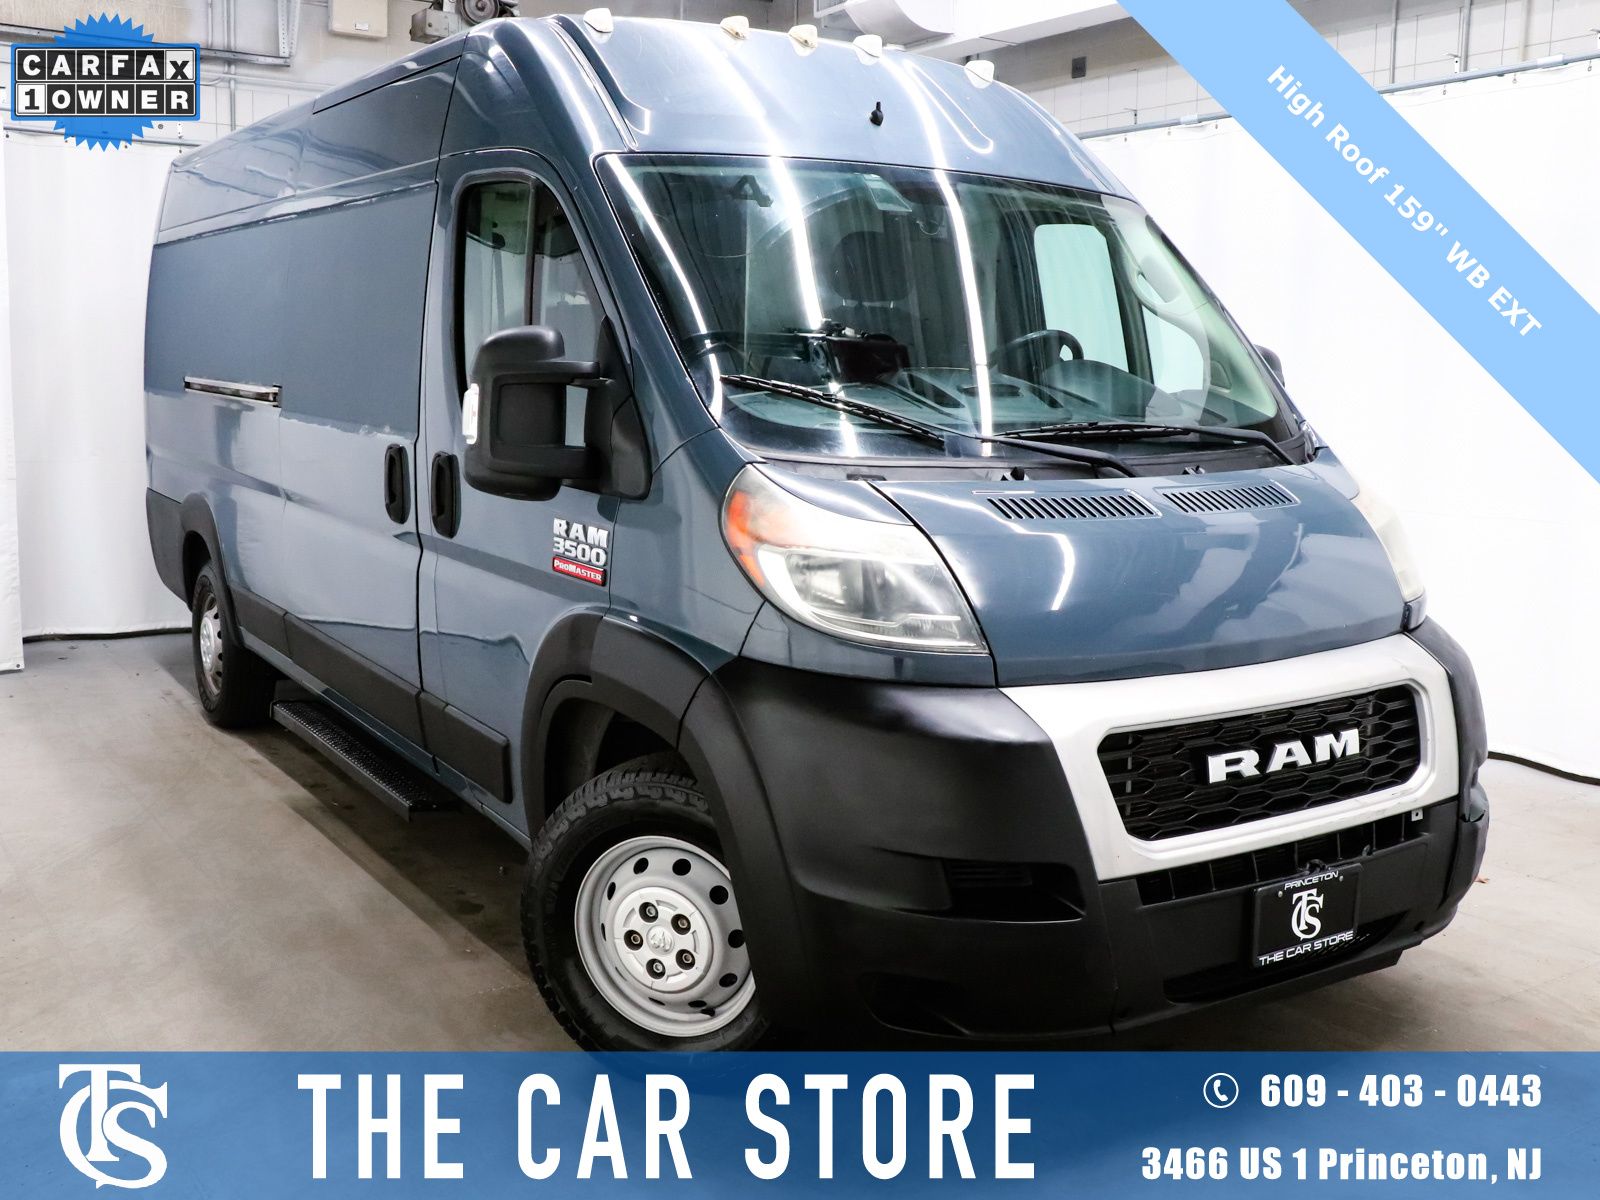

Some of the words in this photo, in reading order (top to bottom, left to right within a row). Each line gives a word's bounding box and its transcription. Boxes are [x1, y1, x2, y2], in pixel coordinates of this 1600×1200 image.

[553, 517, 608, 548] RAM
[553, 536, 606, 567] 3500
[1207, 728, 1360, 784] RAM
[1284, 871, 1339, 890] PRINCETON
[1258, 952, 1284, 966] THE
[1286, 943, 1312, 959] CAR
[1313, 930, 1354, 951] STORE
